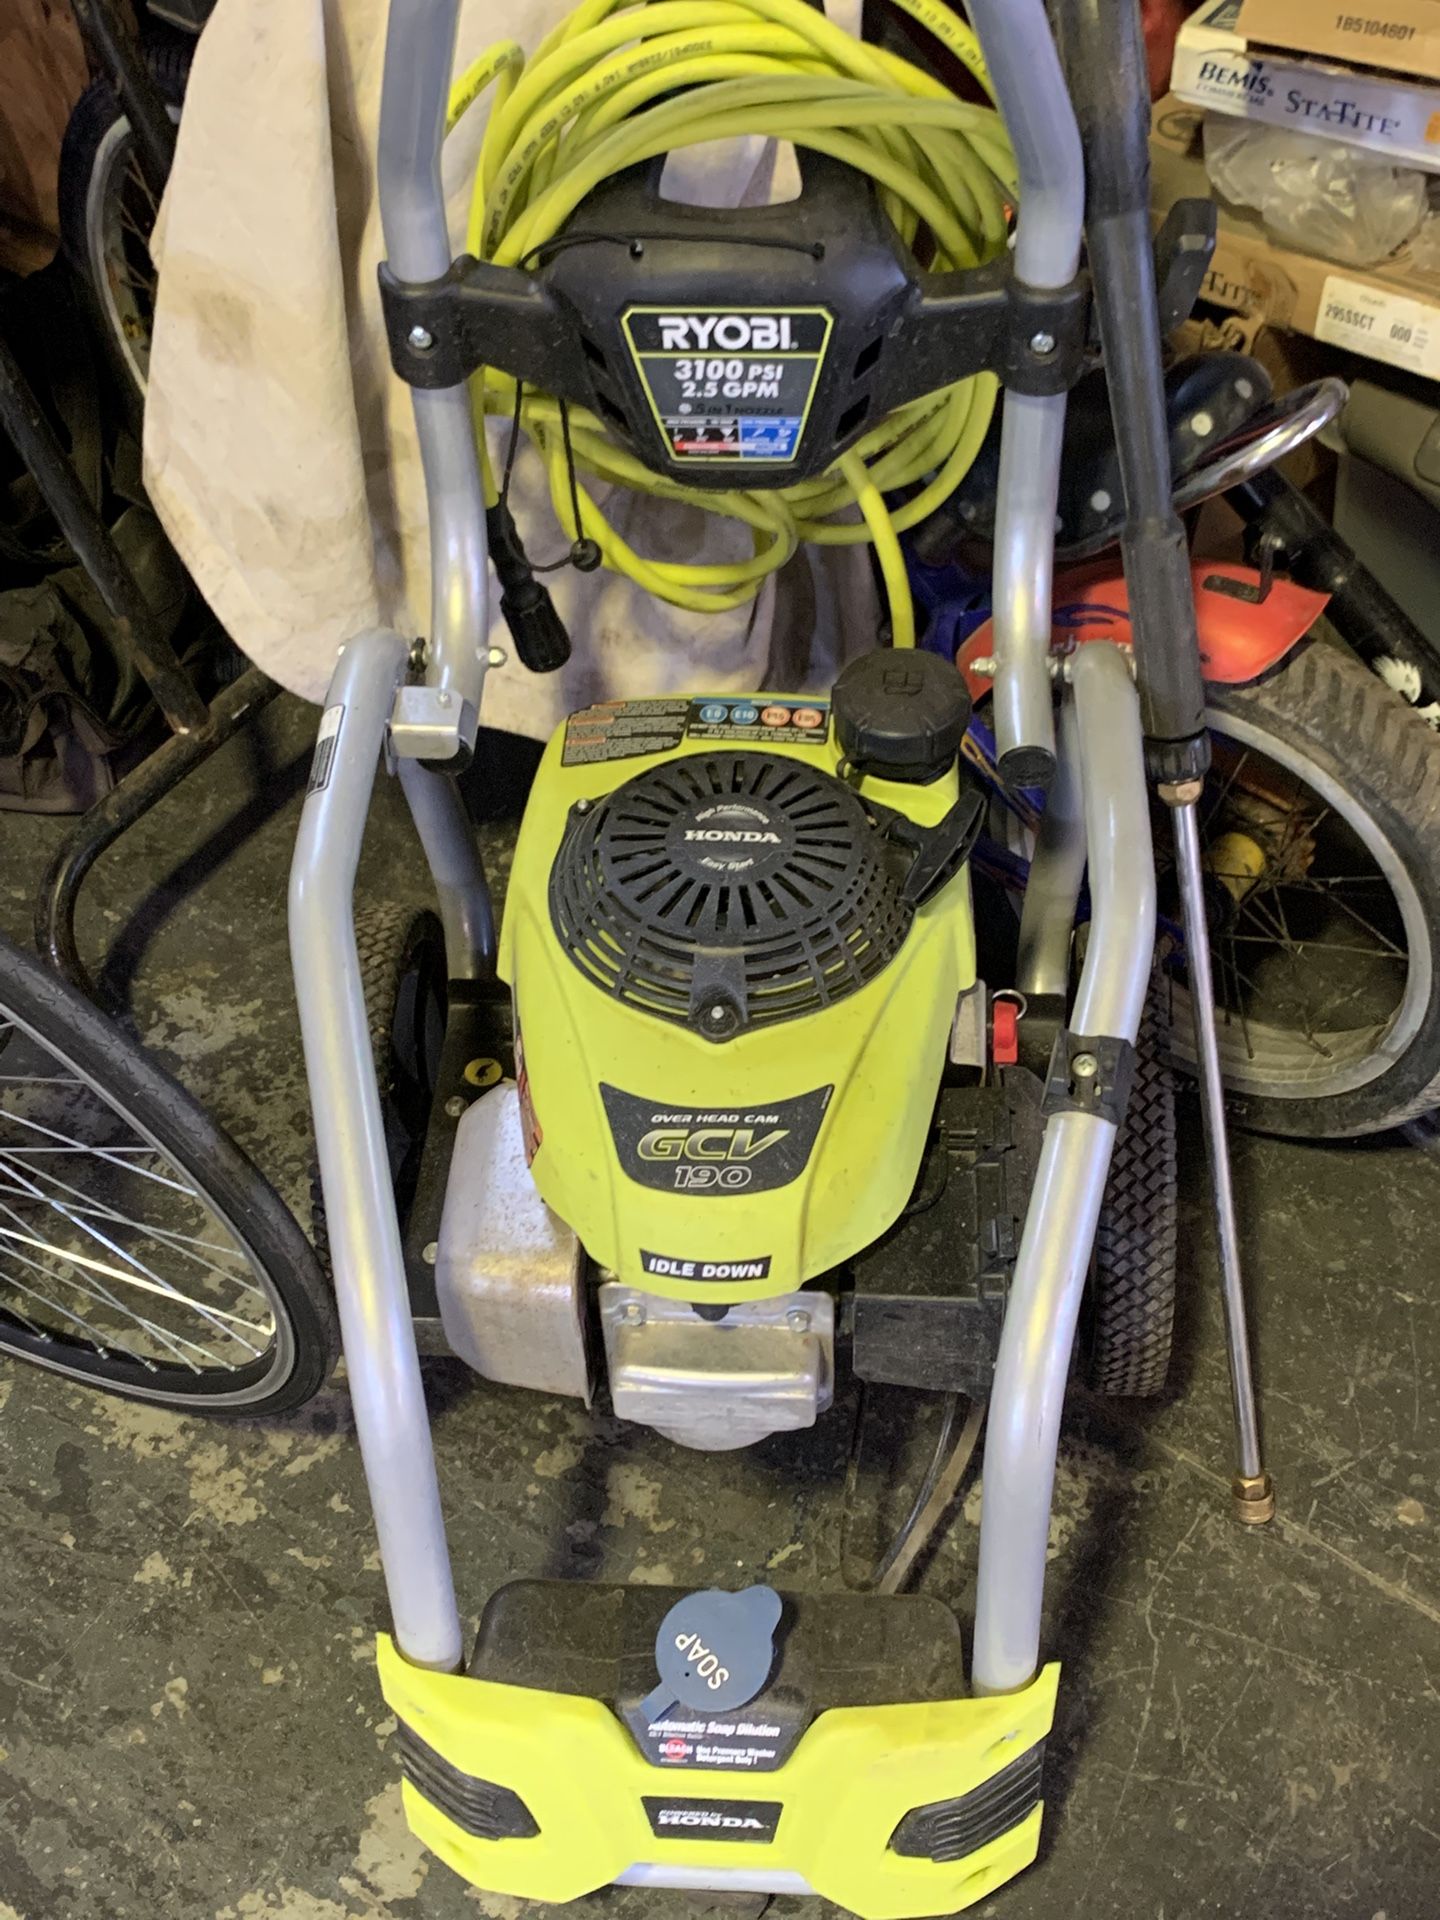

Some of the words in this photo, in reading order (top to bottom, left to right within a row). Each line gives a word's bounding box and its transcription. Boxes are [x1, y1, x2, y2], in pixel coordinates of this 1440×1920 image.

[658, 315, 792, 350] RYOBI
[674, 359, 744, 381] 3100
[748, 364, 784, 381] PSI
[681, 381, 719, 399] 2.5
[722, 381, 780, 399] GPM
[684, 829, 782, 844] HONDA
[651, 1113, 692, 1124] OVER
[696, 1113, 739, 1124] HEAD
[744, 1114, 779, 1125] CAM
[637, 1128, 791, 1161] GCV
[674, 1165, 752, 1188] 190
[649, 1256, 696, 1277] IDLE
[701, 1263, 763, 1279] DOWN
[674, 1632, 730, 1691] SOAP
[657, 1815, 765, 1829] HONDA
